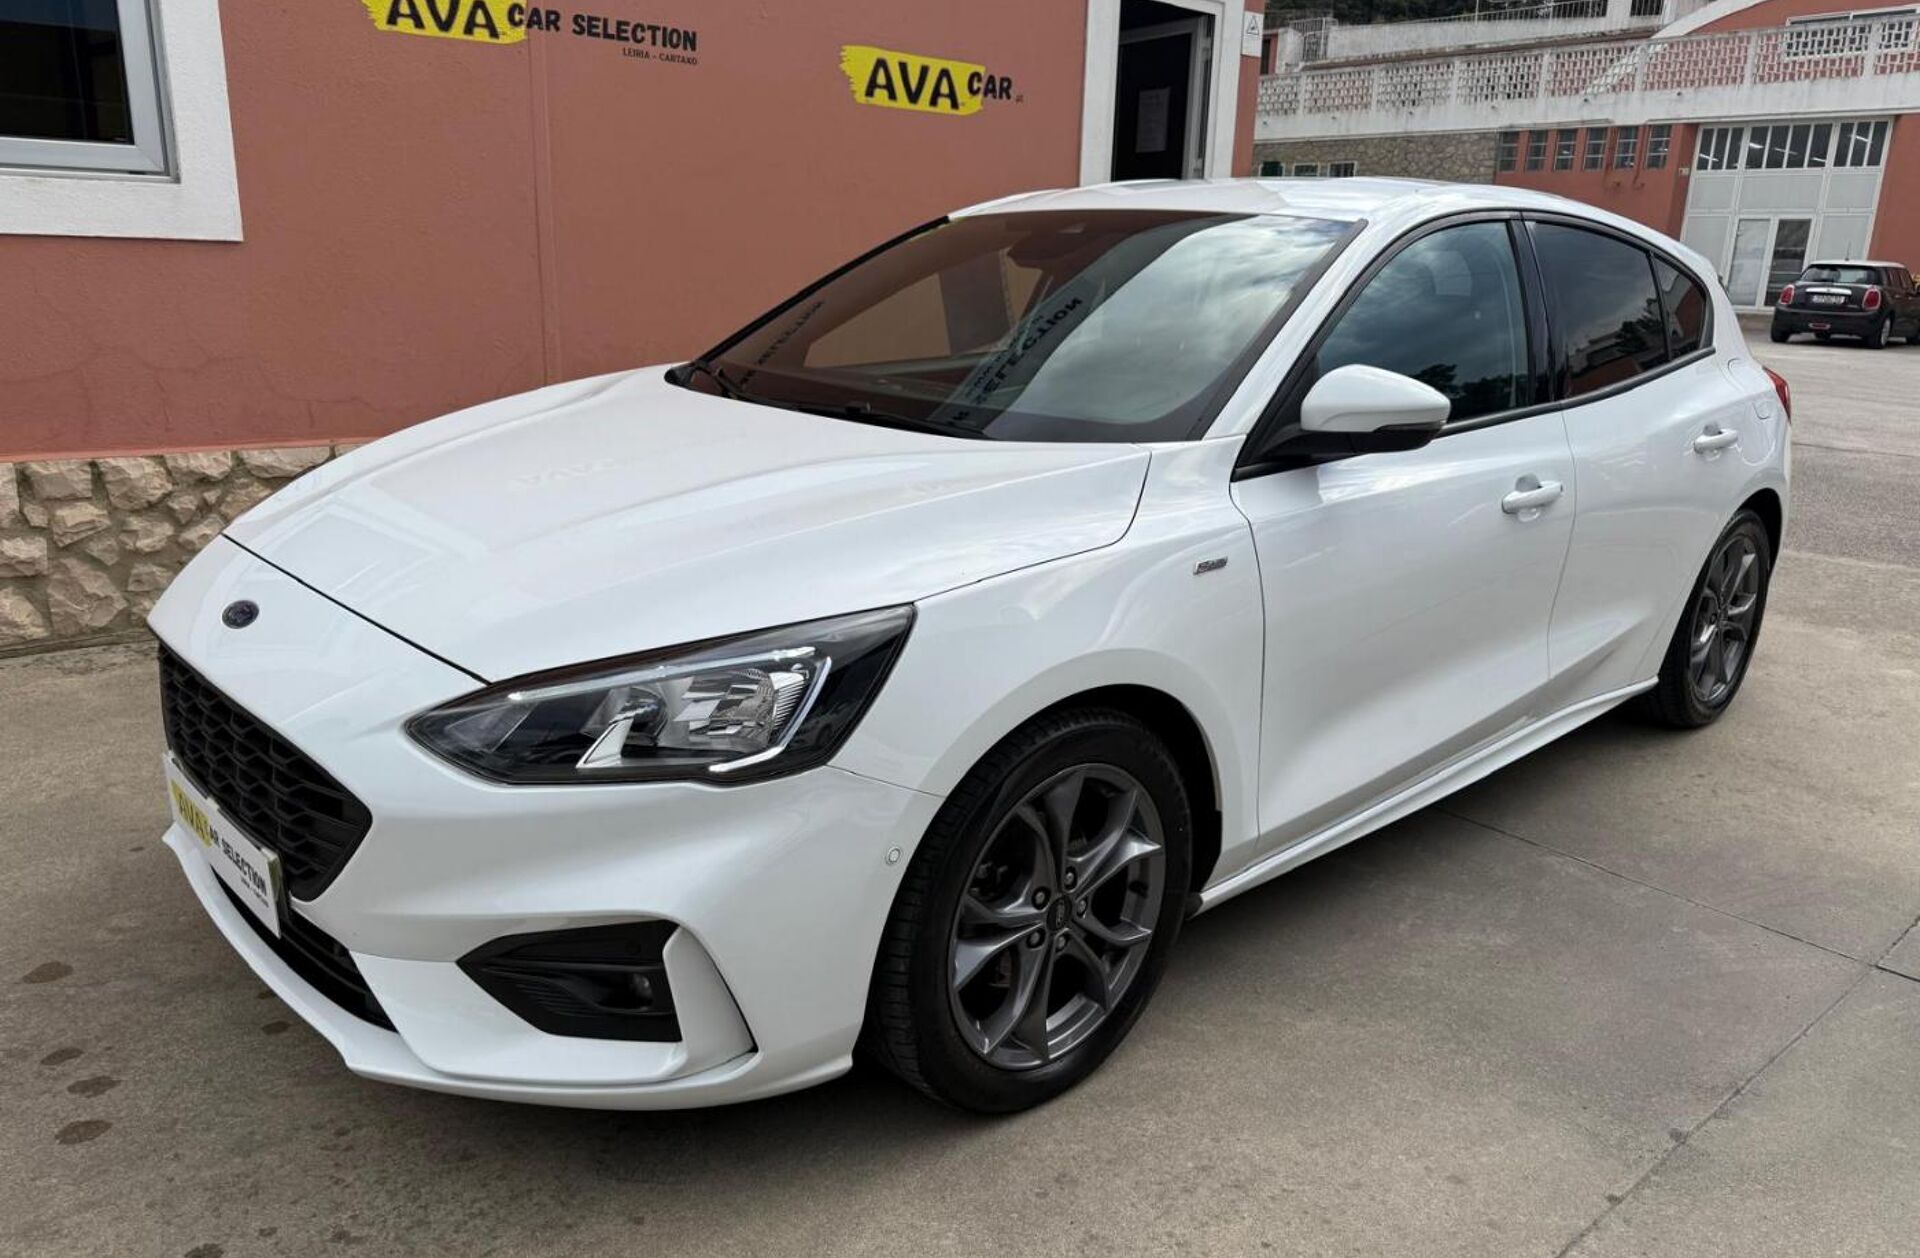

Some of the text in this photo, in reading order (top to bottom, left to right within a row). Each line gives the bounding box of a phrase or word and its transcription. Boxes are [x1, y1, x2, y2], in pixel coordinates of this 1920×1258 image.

[385, 0, 697, 52] AVA CAR SELECTION
[864, 57, 1012, 110] AVA CAR
[221, 838, 267, 897] SELECTION
